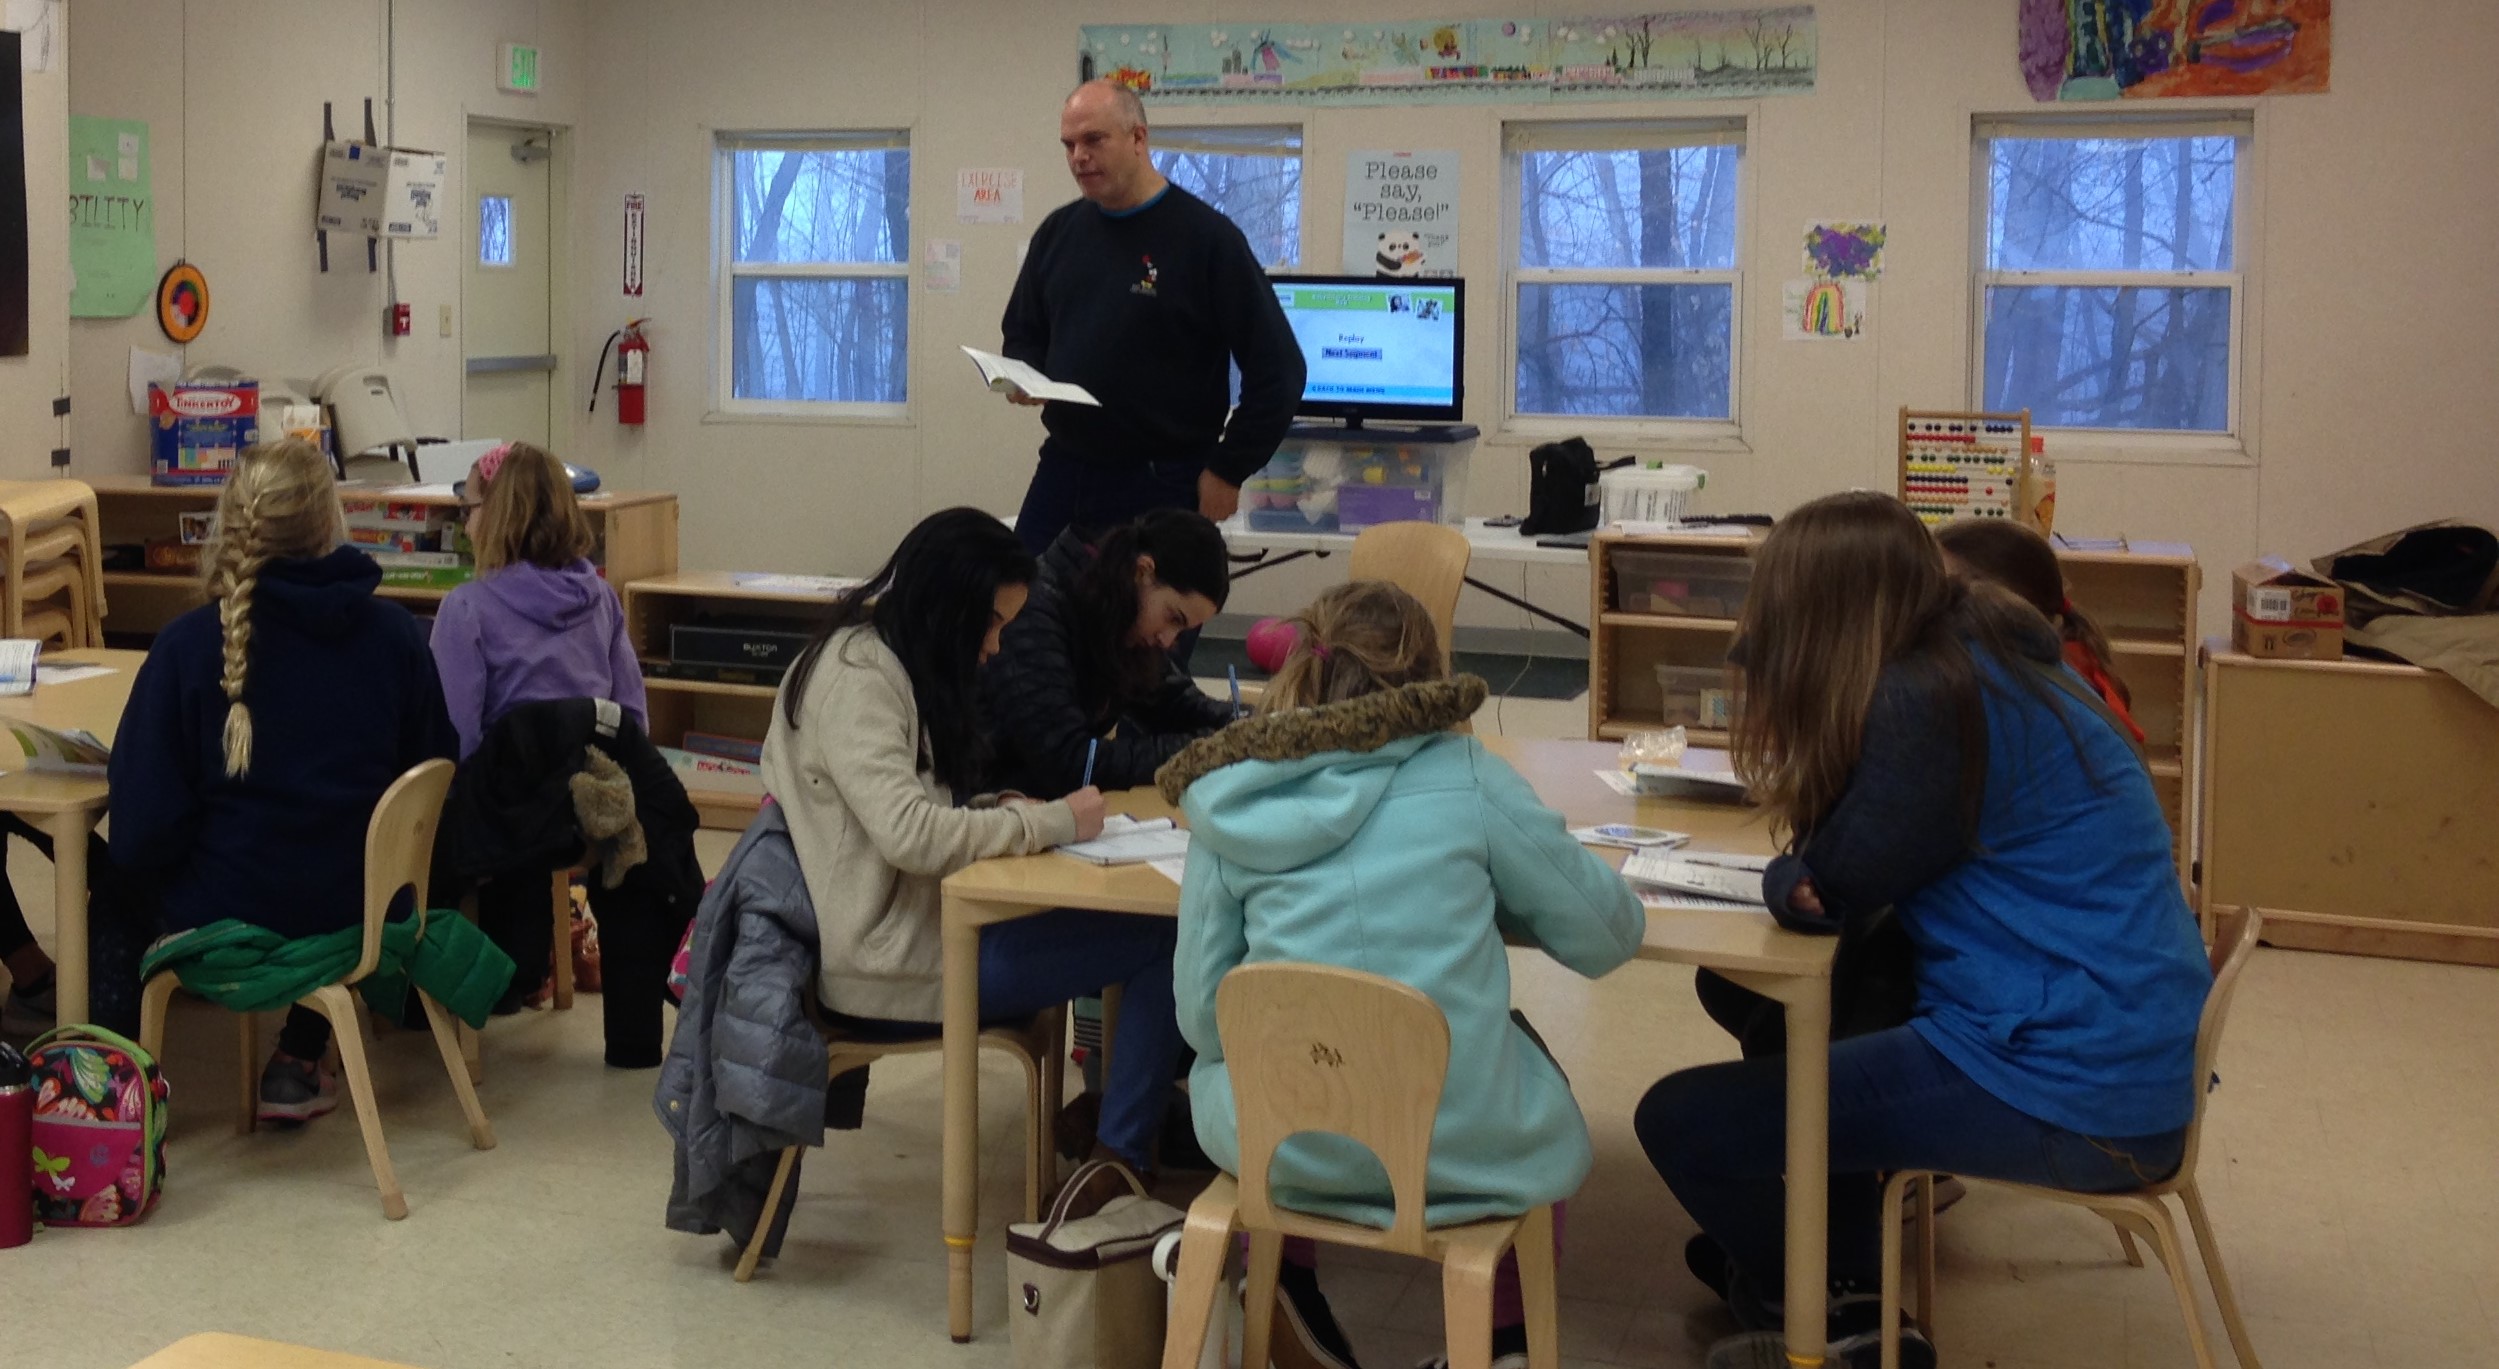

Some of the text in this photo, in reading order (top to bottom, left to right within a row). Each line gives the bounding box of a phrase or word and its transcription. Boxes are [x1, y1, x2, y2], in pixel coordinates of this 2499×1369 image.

[1365, 161, 1438, 180] Please
[1381, 183, 1422, 203] say,
[1338, 333, 1364, 344] Replay
